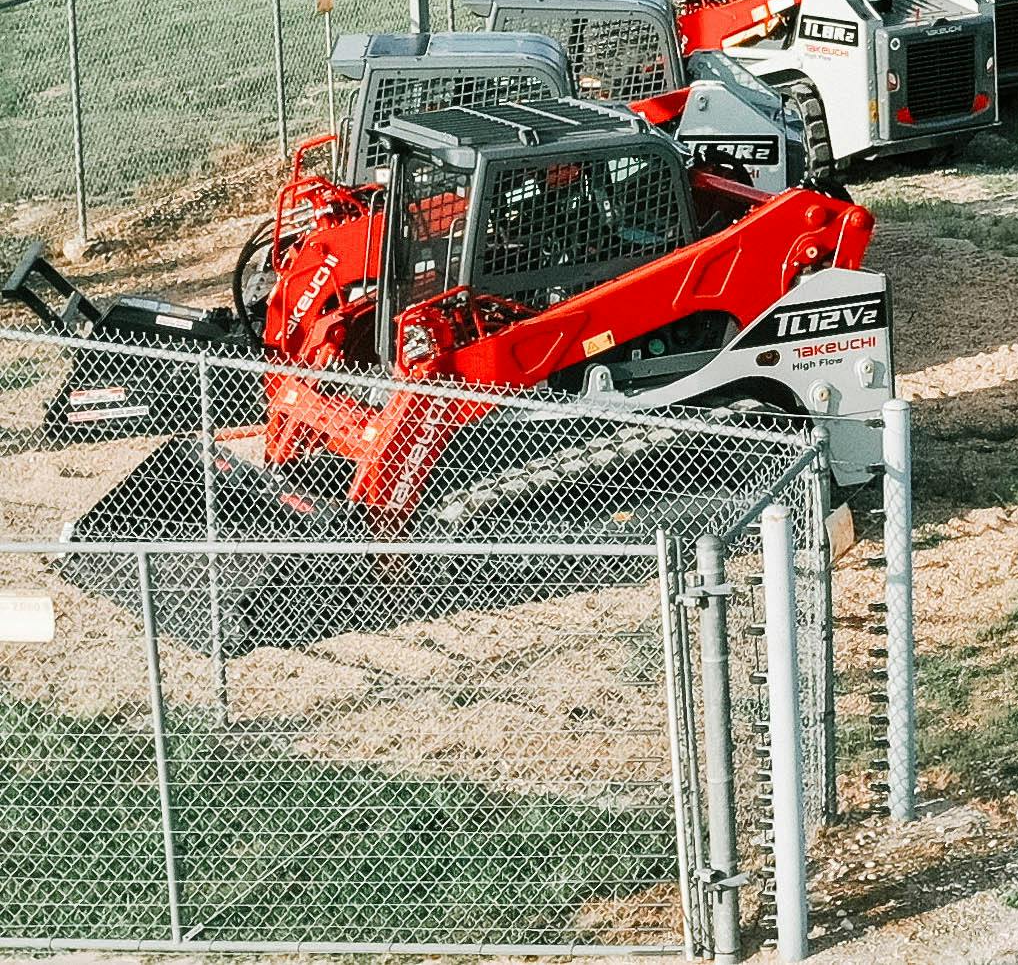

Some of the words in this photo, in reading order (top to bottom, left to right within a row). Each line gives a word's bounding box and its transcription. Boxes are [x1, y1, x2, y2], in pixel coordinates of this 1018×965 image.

[774, 306, 879, 337] TL12V2
[792, 361, 816, 371] High
[820, 357, 844, 367] Flow
